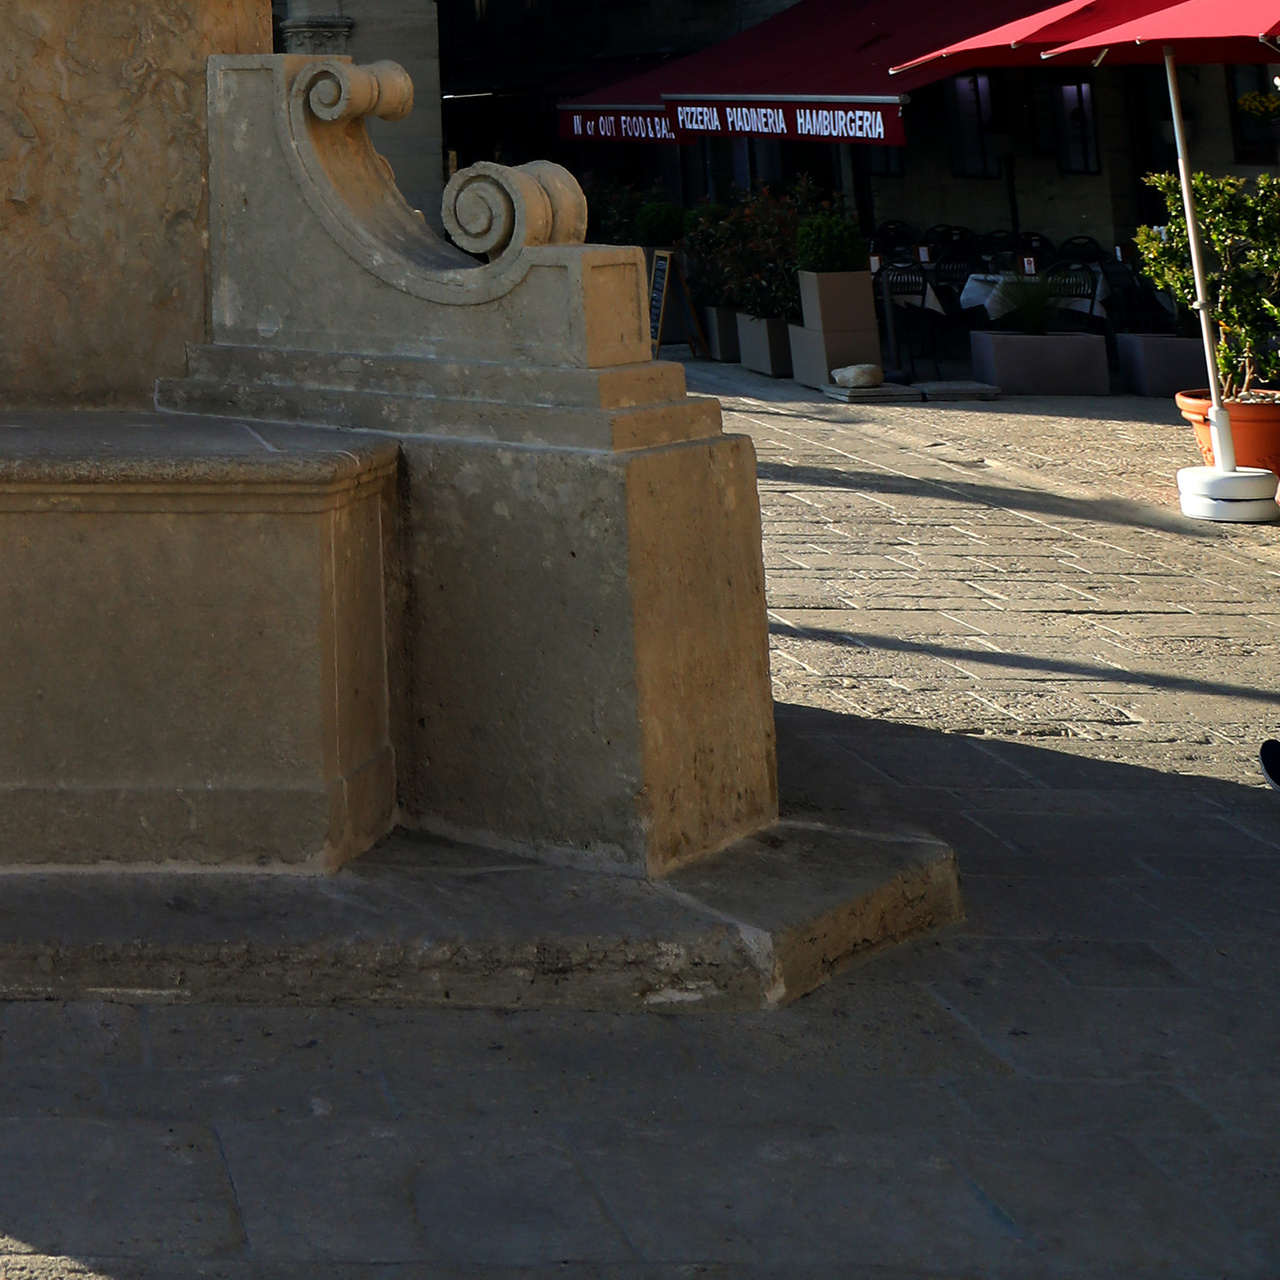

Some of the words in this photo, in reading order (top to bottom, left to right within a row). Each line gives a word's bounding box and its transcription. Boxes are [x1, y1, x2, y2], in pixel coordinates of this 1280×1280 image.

[573, 115, 582, 135] IN
[599, 116, 616, 137] OUT
[621, 115, 646, 138] FOOD
[677, 106, 721, 131] PIZZERIA
[726, 107, 787, 134] PIADINERIA
[796, 109, 885, 139] HAMBURGERIA
